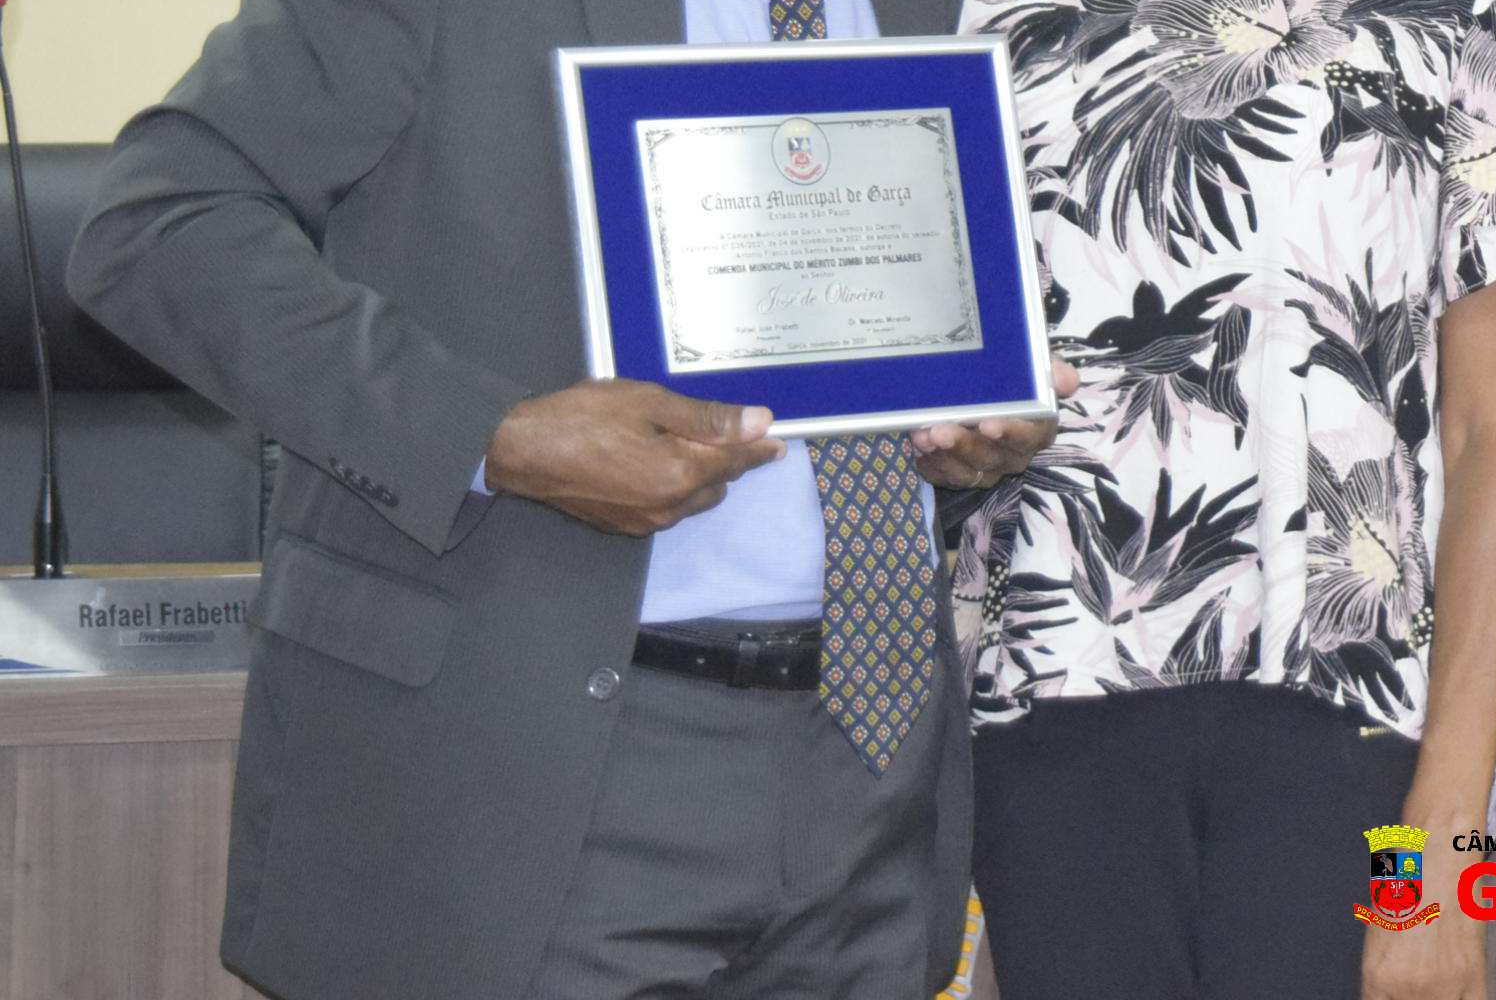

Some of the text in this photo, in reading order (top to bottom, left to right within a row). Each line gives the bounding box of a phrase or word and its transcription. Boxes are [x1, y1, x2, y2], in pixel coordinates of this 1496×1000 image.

[701, 185, 912, 211] Câmara Municipal de Garça
[707, 263, 747, 276] COMENDA
[748, 260, 792, 273] MUNICIPAL
[793, 260, 806, 270] DO
[882, 252, 922, 264] PALMARES
[824, 279, 886, 305] Oliveira
[79, 600, 247, 628] Rafael Frabetti
